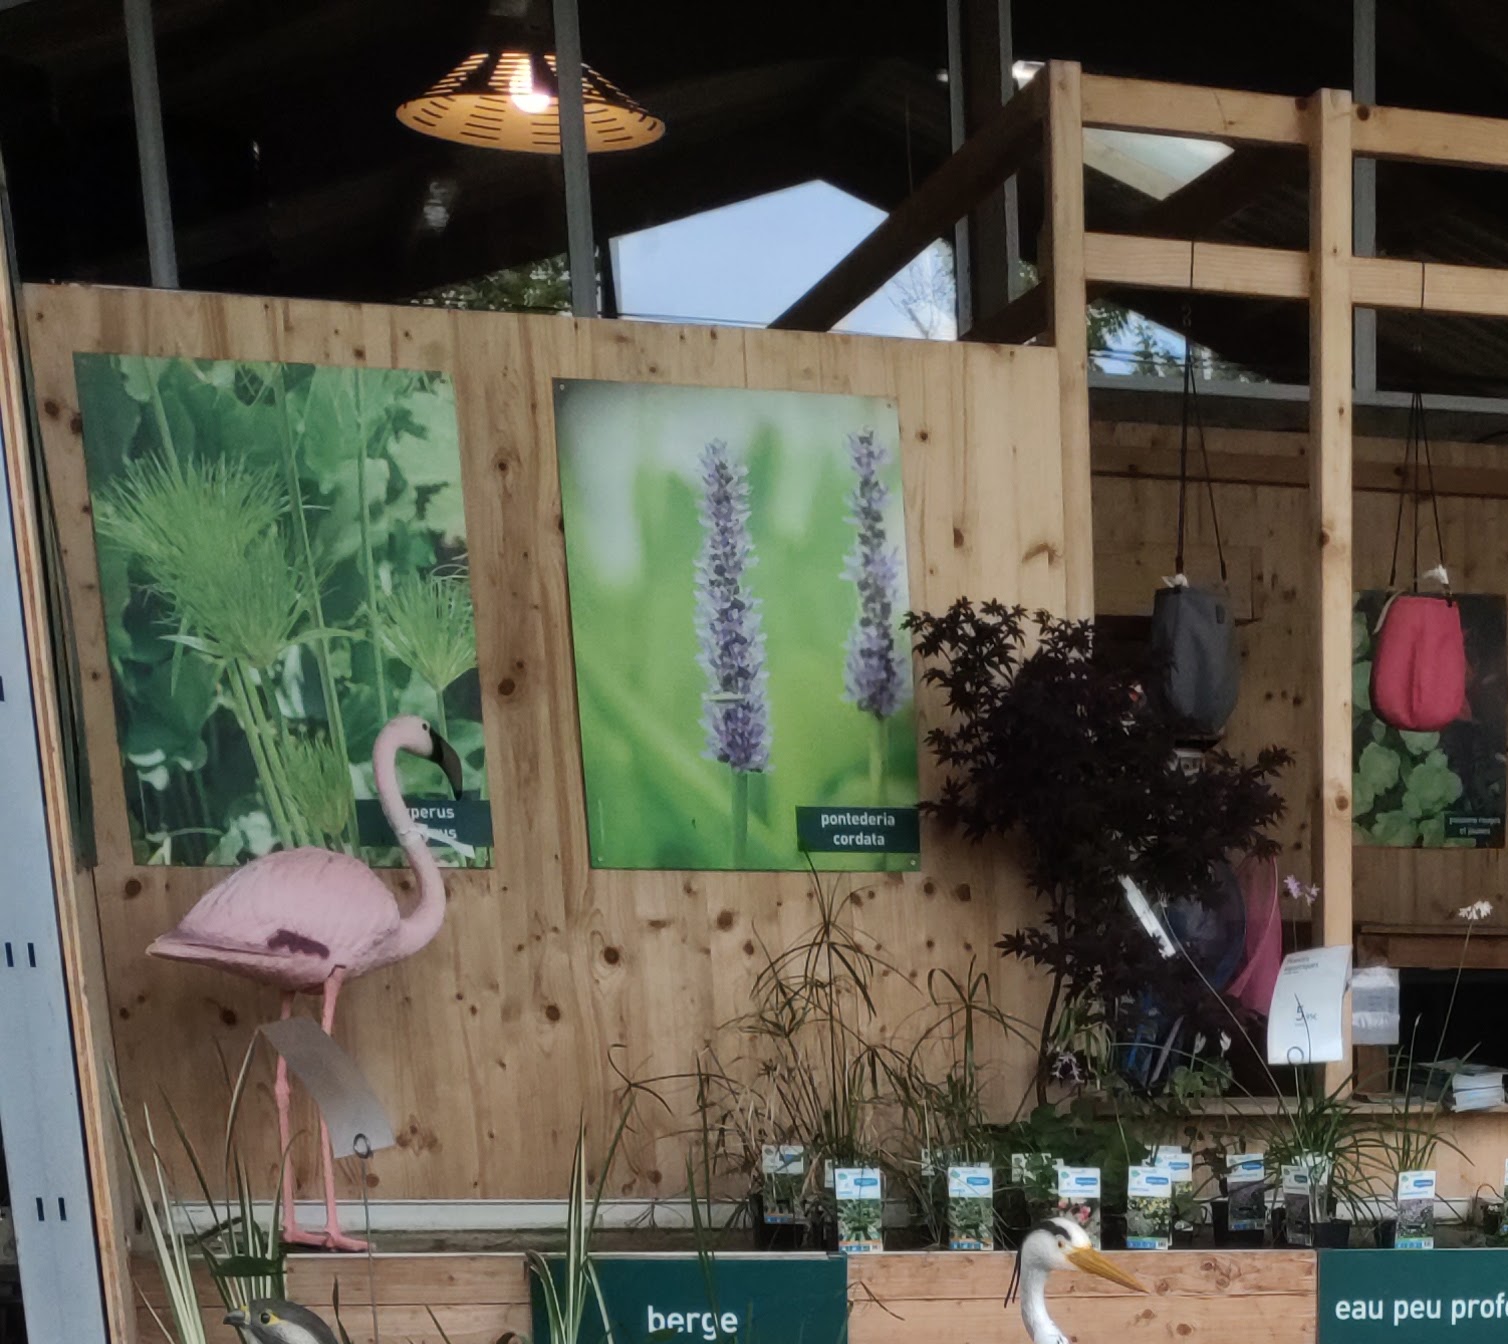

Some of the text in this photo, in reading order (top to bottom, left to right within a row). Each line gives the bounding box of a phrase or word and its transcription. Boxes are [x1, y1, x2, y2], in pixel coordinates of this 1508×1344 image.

[405, 807, 455, 819] perus
[821, 812, 896, 828] pontederia
[833, 832, 885, 845] cordata
[1335, 1299, 1384, 1320] eau
[1393, 1299, 1442, 1326] peu
[647, 1305, 738, 1340] berge
